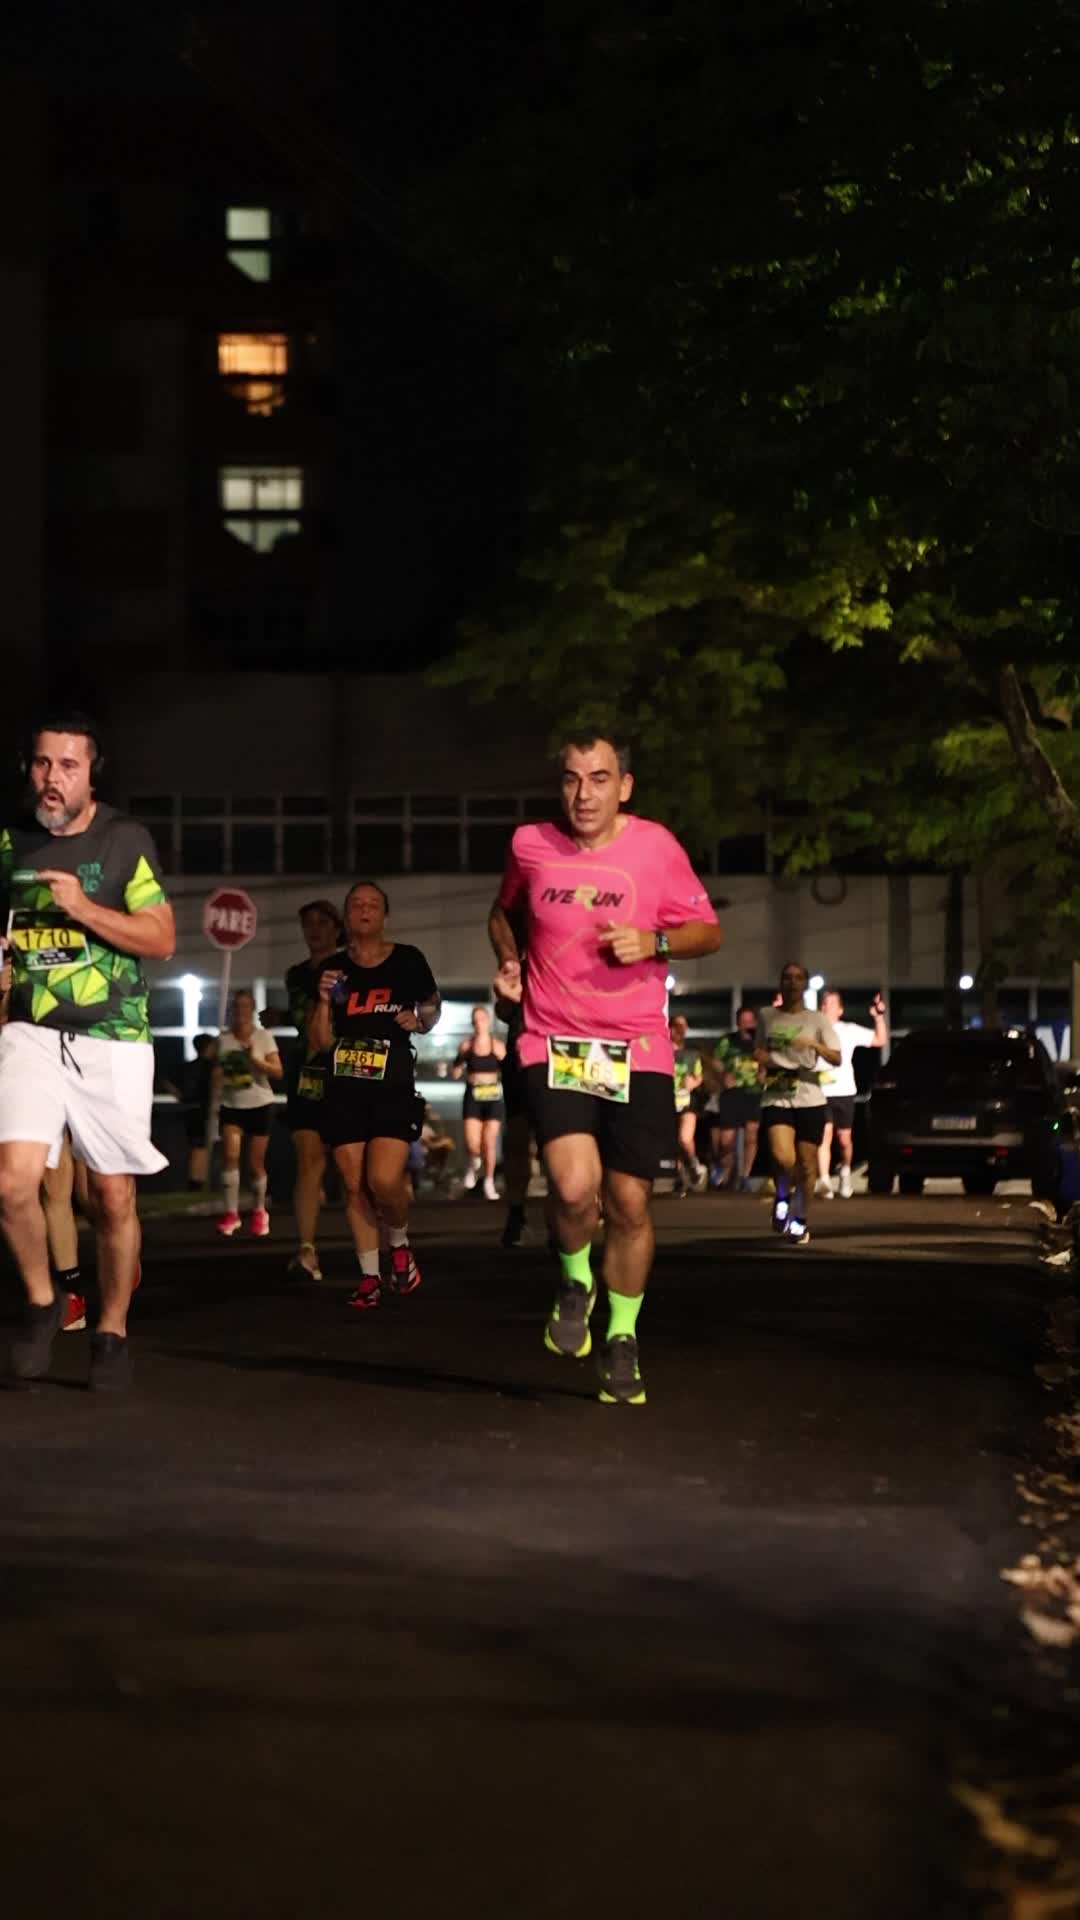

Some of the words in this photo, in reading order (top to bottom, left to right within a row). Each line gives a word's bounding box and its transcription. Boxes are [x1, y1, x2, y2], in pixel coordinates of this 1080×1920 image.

[207, 908, 252, 934] PARE
[23, 928, 70, 948] 1710
[347, 989, 390, 1016] LP
[374, 1004, 403, 1013] RUN
[344, 1049, 375, 1065] 2361
